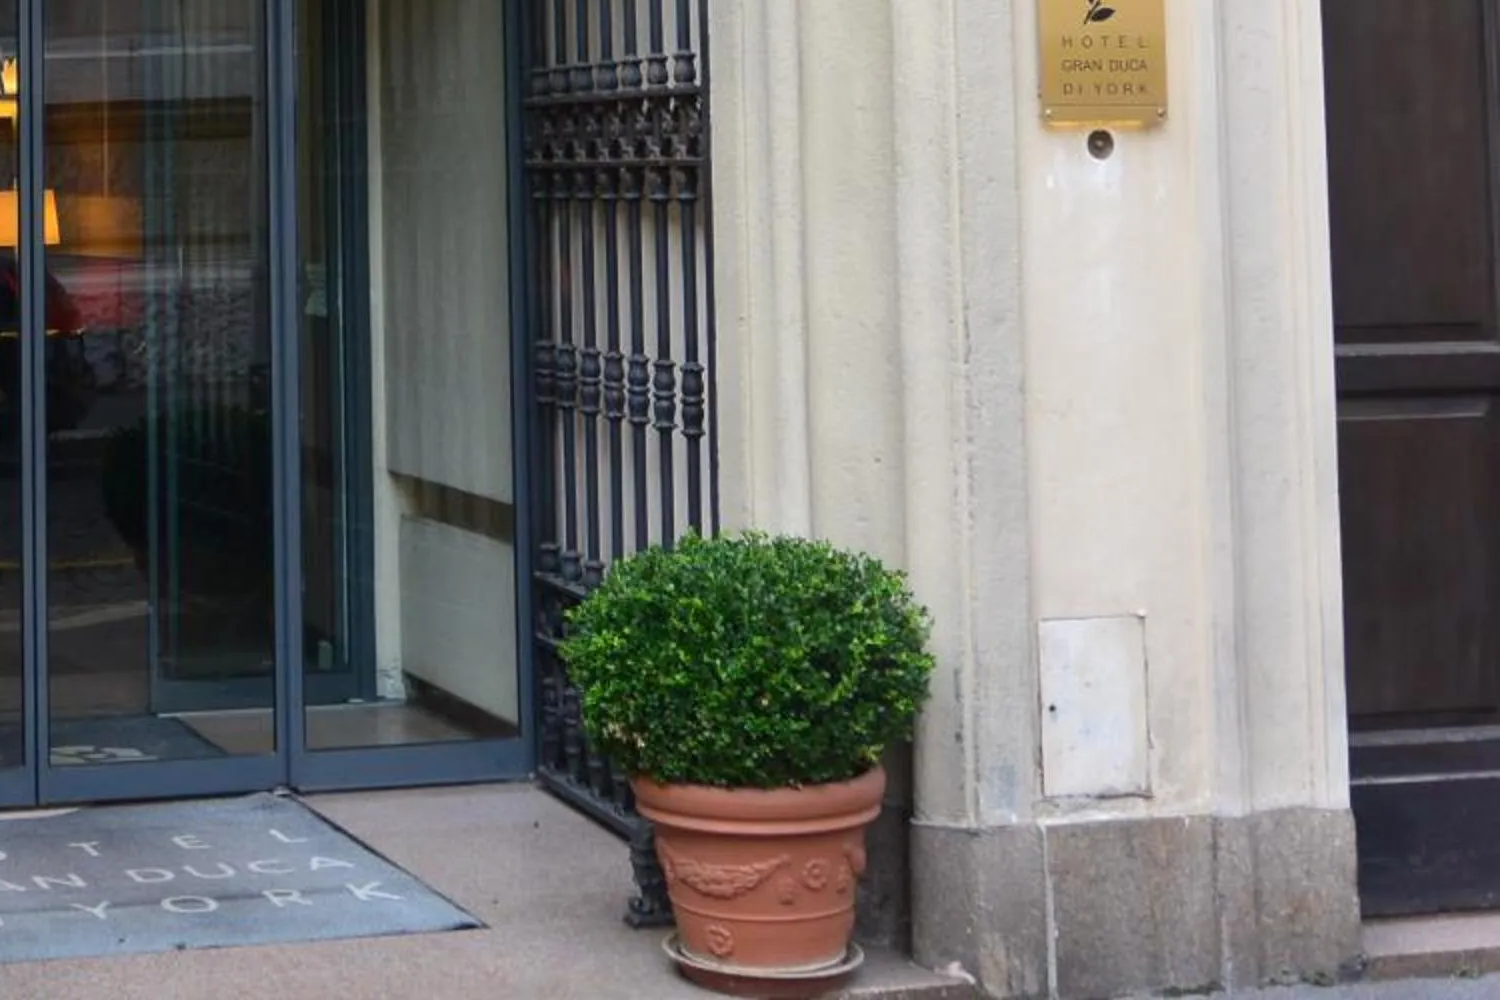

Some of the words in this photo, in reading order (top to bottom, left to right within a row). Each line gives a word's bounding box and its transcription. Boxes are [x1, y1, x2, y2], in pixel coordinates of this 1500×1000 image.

[1061, 35, 1149, 49] HOTEL
[1061, 59, 1103, 73] GRAN
[1109, 59, 1148, 73] DUCA
[1063, 83, 1083, 96] DI
[1094, 83, 1148, 96] YORK
[125, 856, 355, 883] DUCA
[70, 880, 405, 920] YORK
